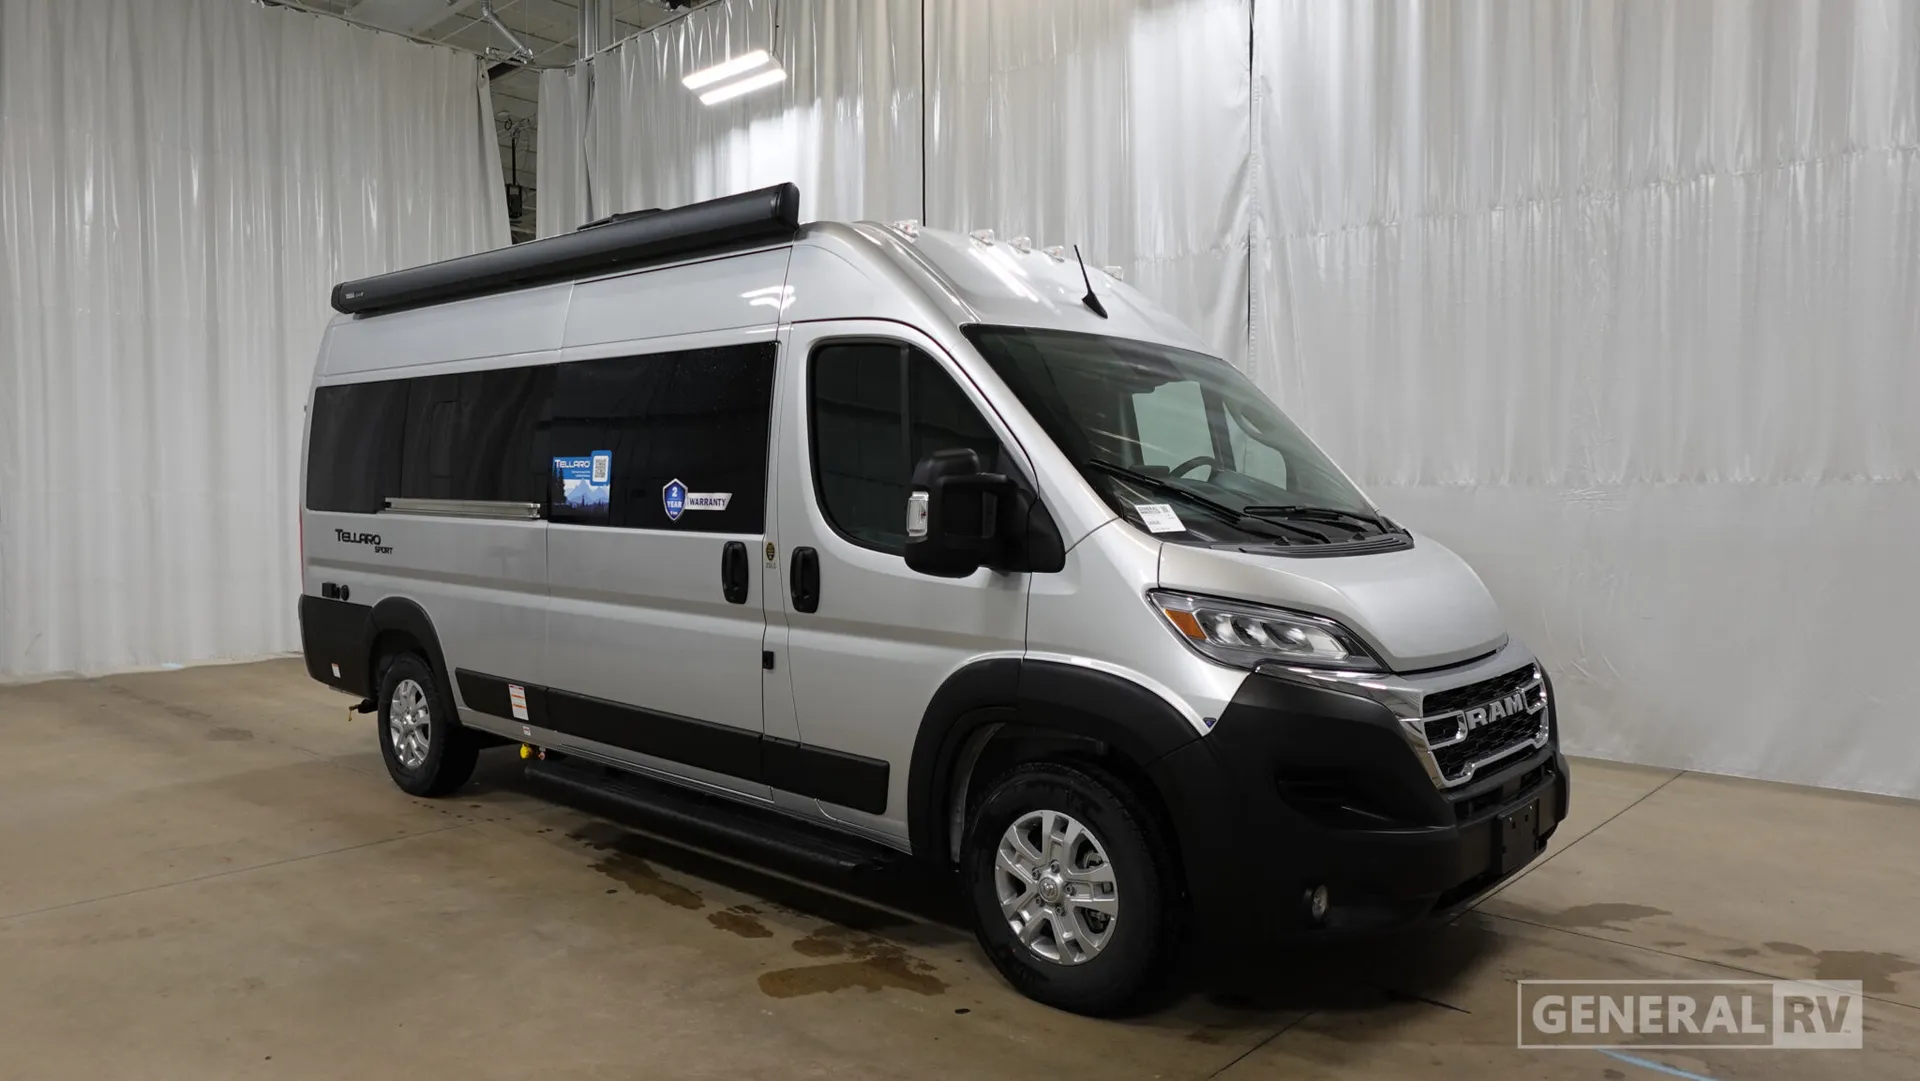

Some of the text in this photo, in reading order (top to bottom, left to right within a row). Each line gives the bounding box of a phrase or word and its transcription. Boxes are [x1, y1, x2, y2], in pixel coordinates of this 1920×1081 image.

[554, 459, 590, 469] TELLARO
[671, 486, 678, 497] 2
[667, 500, 682, 509] YEAR
[689, 497, 726, 507] WARRANTY
[374, 546, 393, 554] SPORT
[1465, 693, 1524, 730] RAM
